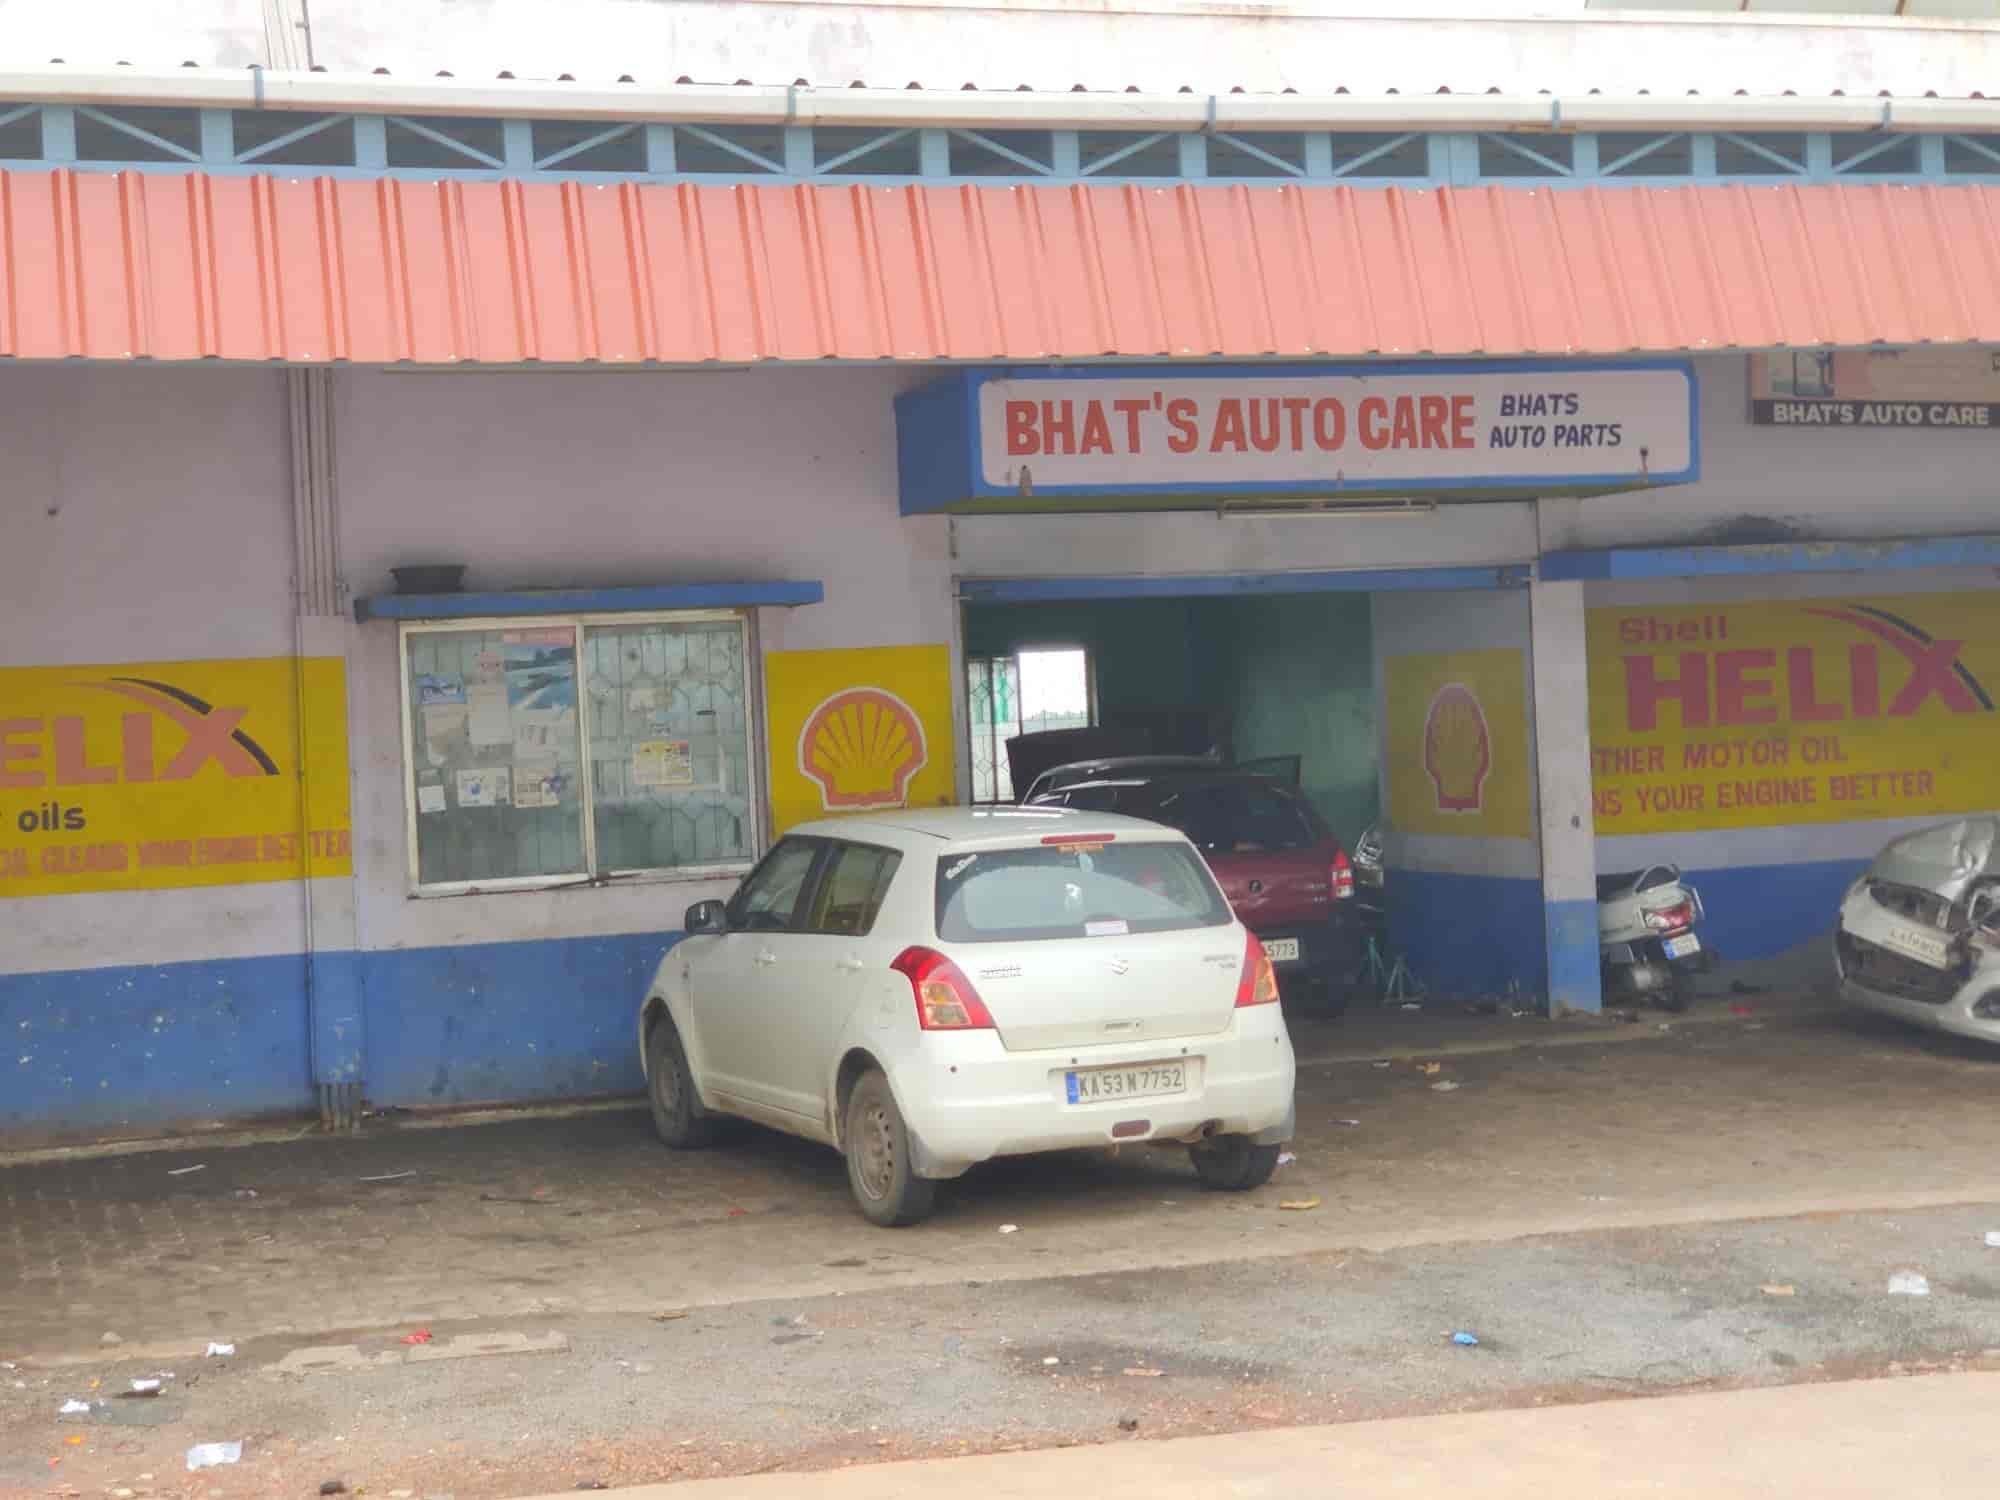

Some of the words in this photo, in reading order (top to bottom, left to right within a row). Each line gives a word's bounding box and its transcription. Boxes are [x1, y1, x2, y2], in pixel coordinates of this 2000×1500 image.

[1500, 393, 1579, 417] BHATS
[1773, 403, 1854, 424] BHAT'S
[1859, 405, 1923, 425] AUTO
[1928, 406, 1989, 426] CARE
[1004, 391, 1199, 456] BHAT'S
[1208, 397, 1346, 452] AUTO
[1358, 395, 1476, 450] CARE
[1490, 425, 1546, 449] AUTO
[1553, 423, 1622, 448] PARTS
[1618, 616, 1728, 645] Shell
[1623, 638, 1979, 732] HELIX
[0, 706, 263, 790] ELIX
[1590, 744, 1664, 776] THER
[1683, 737, 1790, 770] MOTOR
[1801, 735, 1849, 765] OIL
[1636, 783, 1705, 815] YOUR
[1716, 776, 1817, 809] ENGINE
[1829, 770, 1936, 801] BETTER
[17, 801, 87, 833] oils
